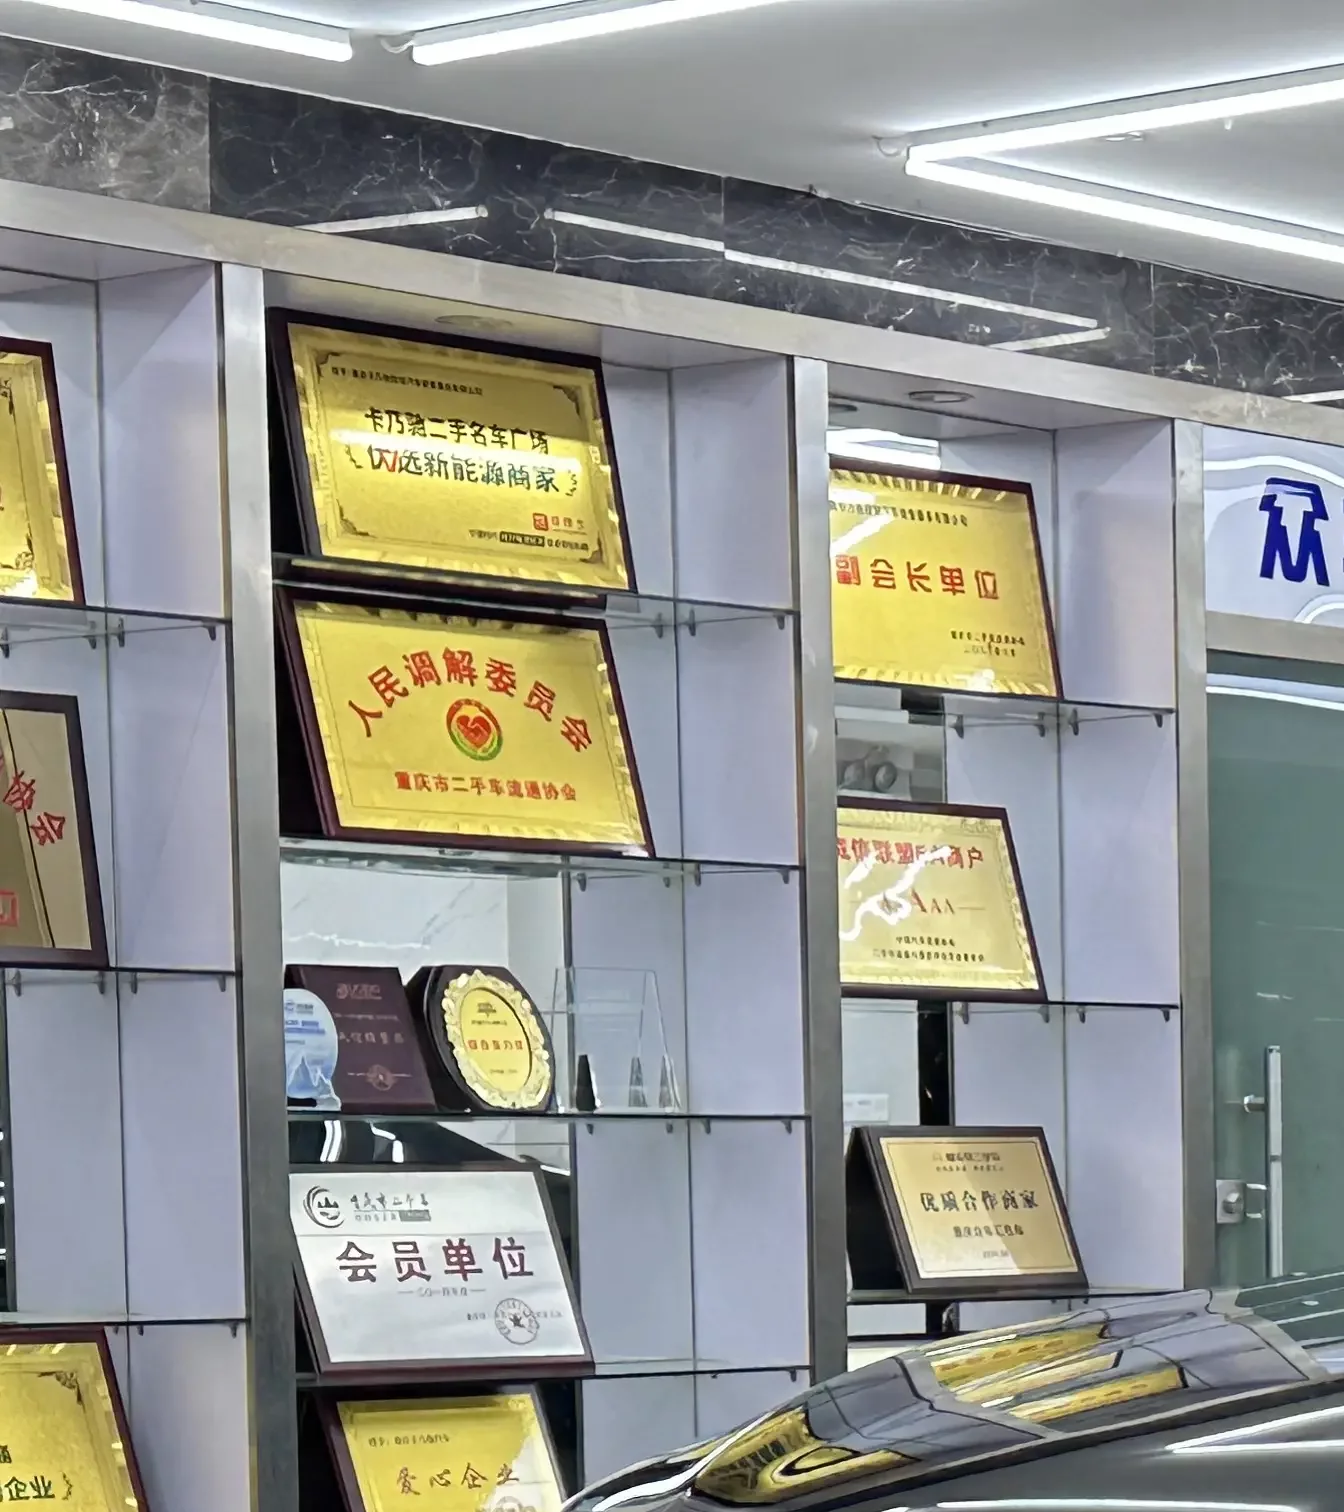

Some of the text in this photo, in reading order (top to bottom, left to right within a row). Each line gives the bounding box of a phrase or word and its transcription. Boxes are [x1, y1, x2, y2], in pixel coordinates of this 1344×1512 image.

[835, 553, 1000, 601] 副会长单位
[347, 646, 593, 754] 人民调解委员会
[334, 1236, 535, 1284] 会员单位
[0, 1474, 56, 1504] 企业
[395, 1461, 520, 1497] 爱心企业
